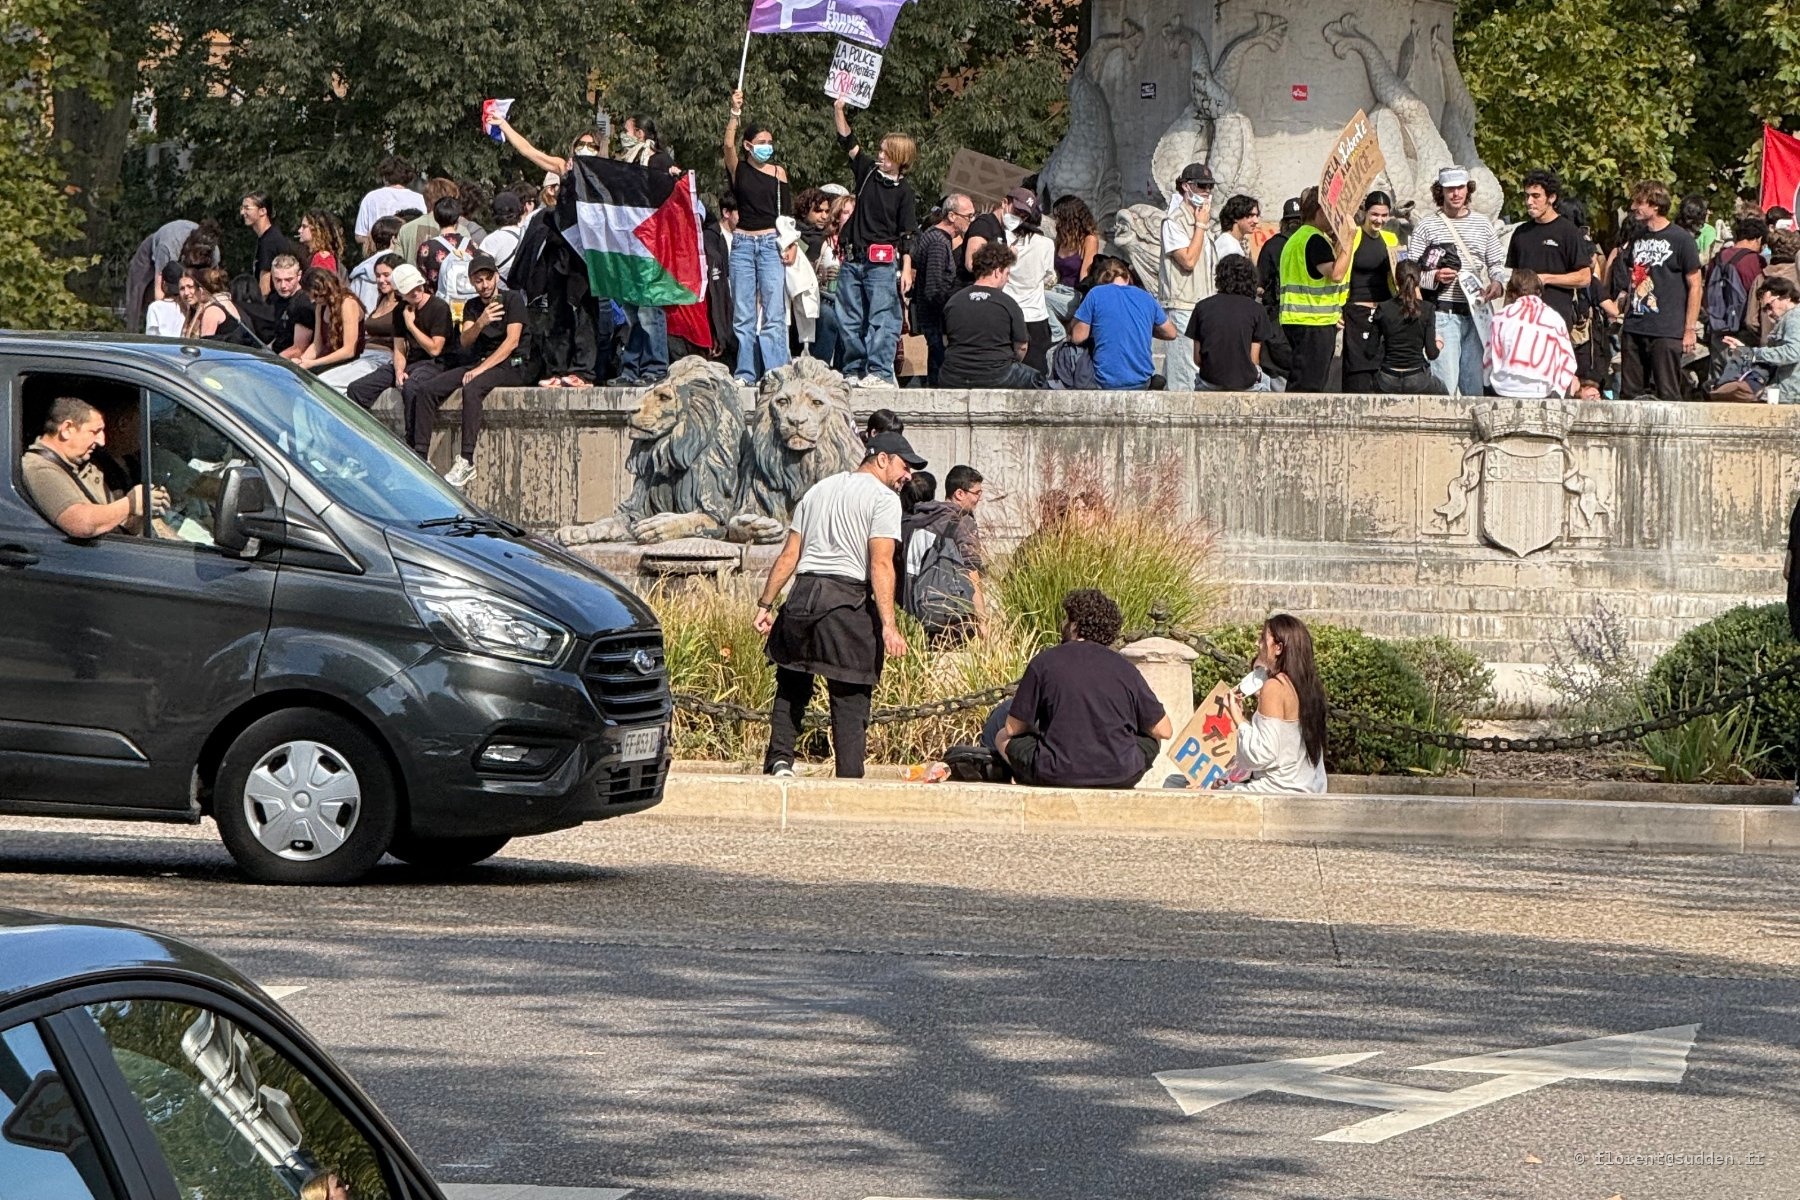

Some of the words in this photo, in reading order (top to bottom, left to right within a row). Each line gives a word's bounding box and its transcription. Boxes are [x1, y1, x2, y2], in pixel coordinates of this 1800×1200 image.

[827, 0, 837, 11] LA
[835, 44, 847, 59] LA
[849, 46, 876, 67] POLICE
[831, 59, 853, 73] NOUS
[1338, 119, 1368, 164] Liberté
